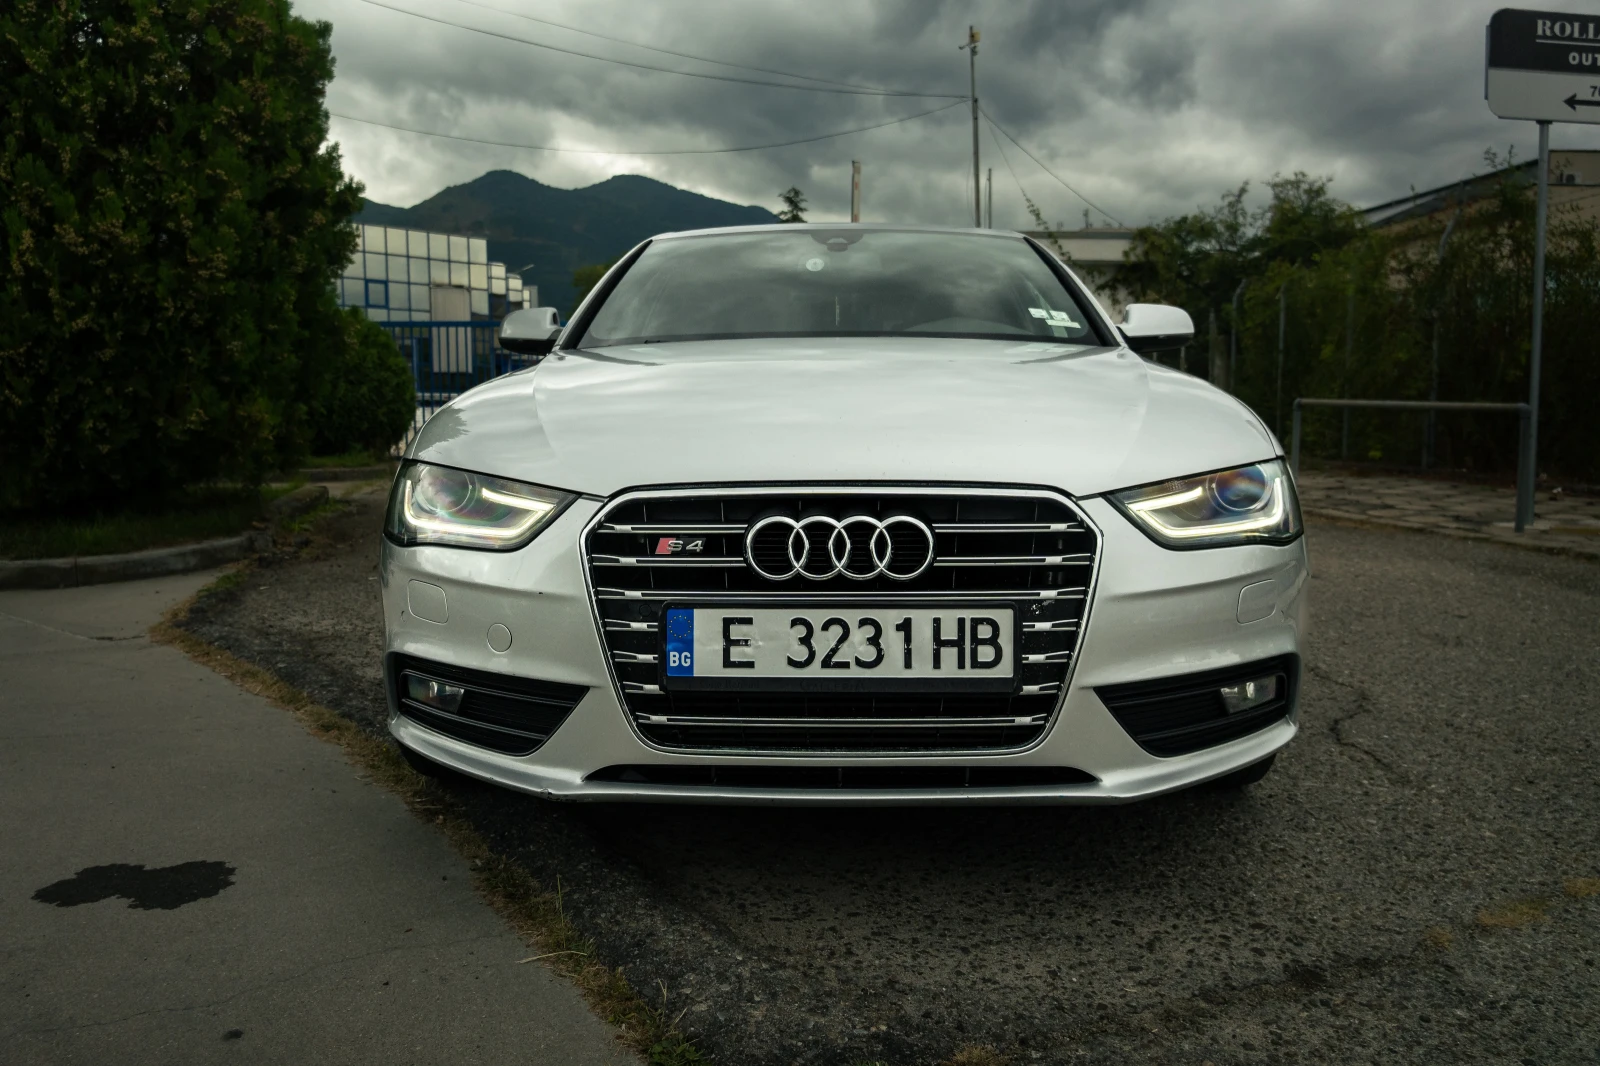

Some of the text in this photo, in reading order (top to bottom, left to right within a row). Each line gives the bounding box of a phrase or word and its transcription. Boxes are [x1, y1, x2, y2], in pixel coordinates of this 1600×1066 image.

[667, 540, 703, 552] S4
[722, 616, 1003, 669] E 3231 HB
[669, 651, 691, 667] BG
